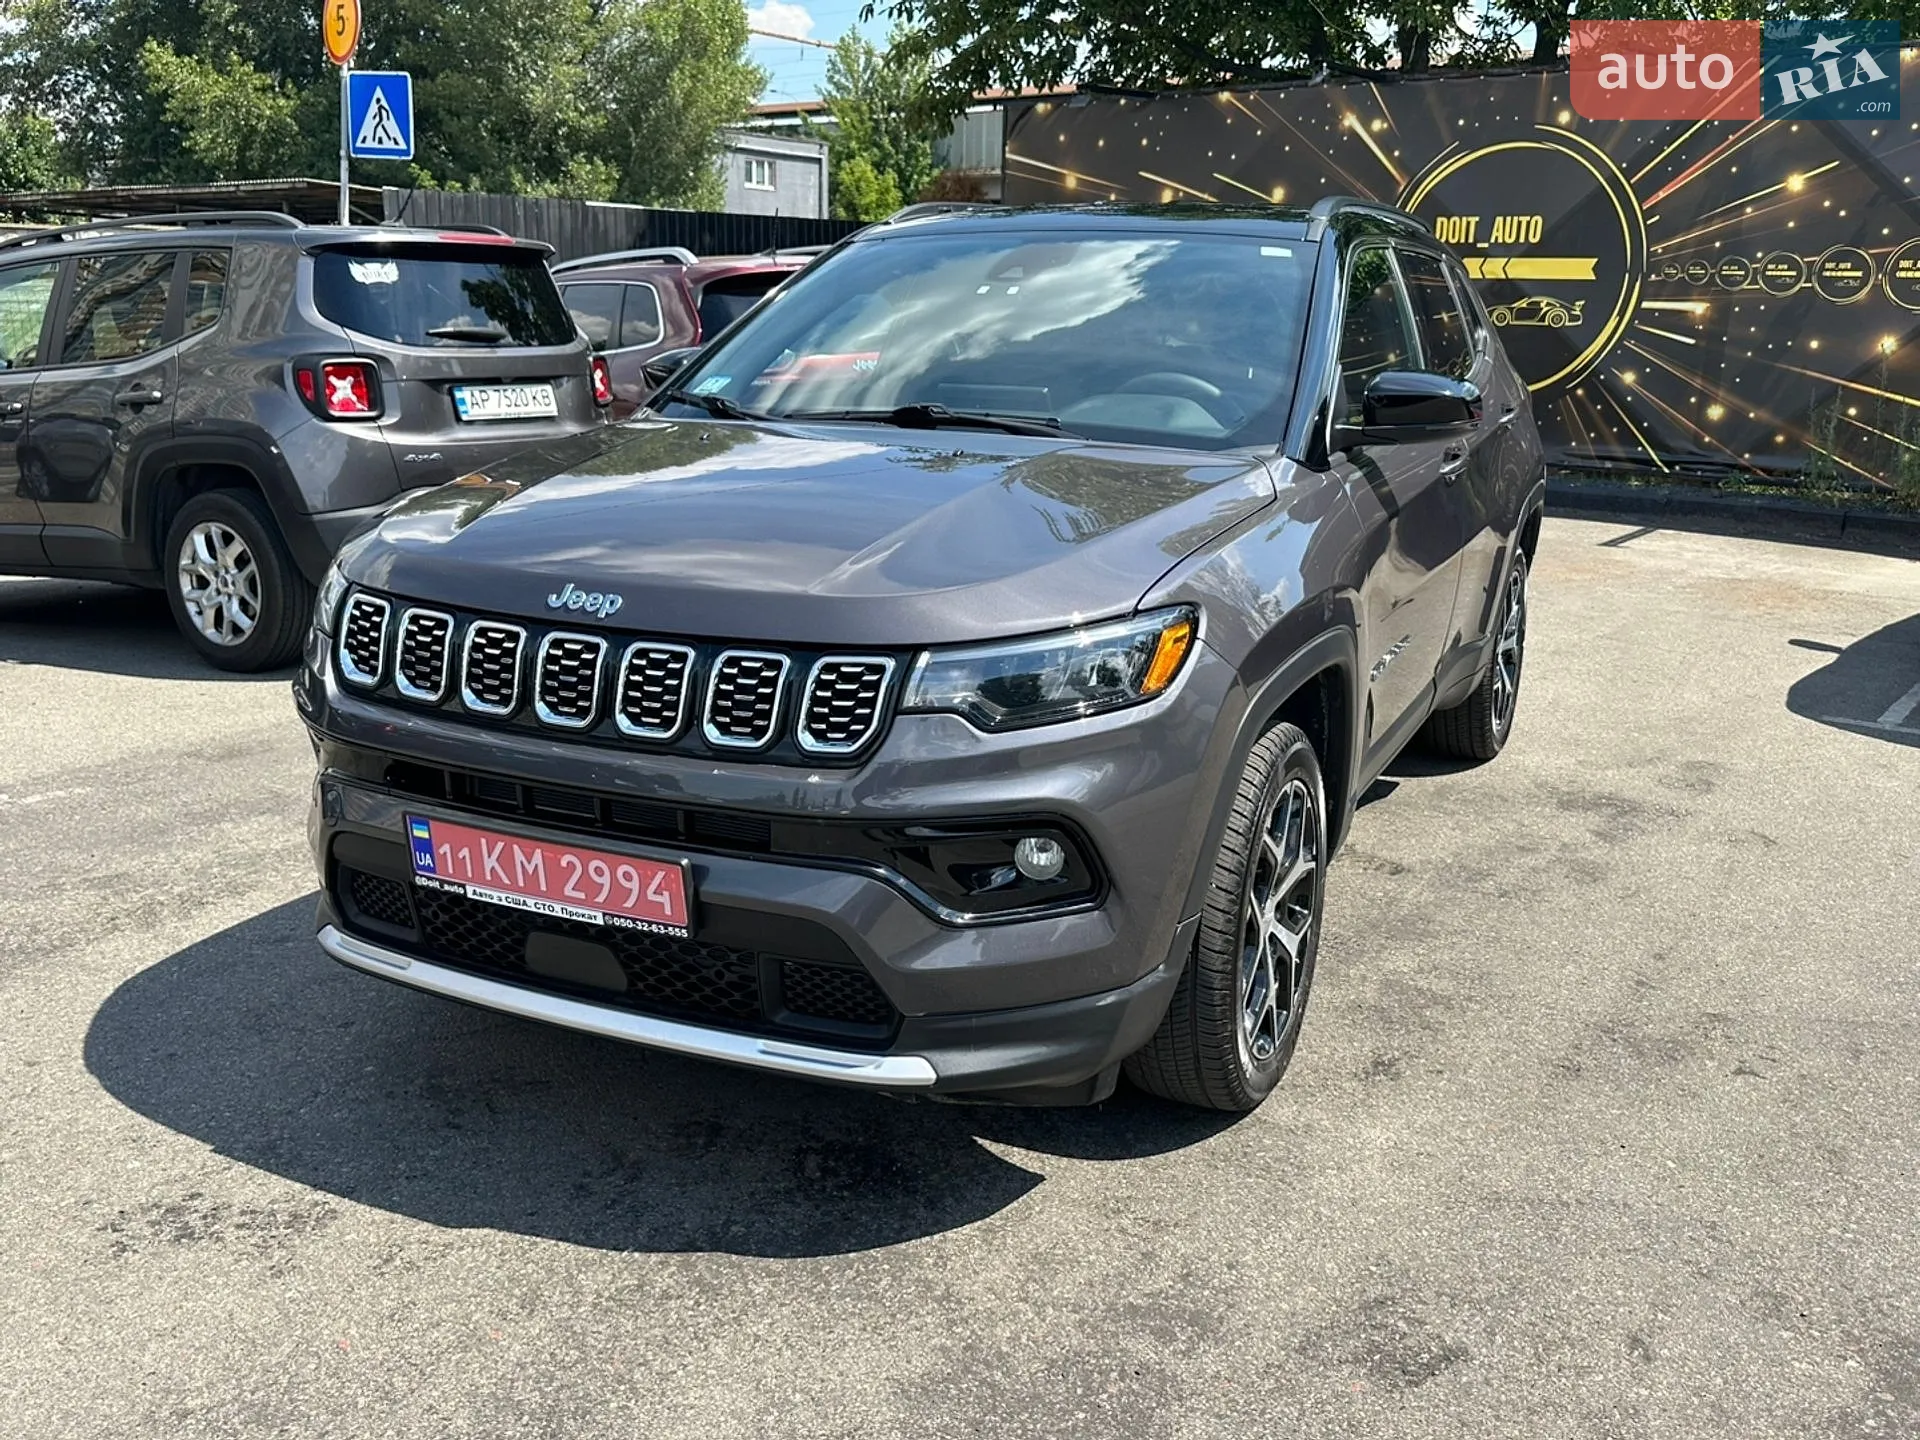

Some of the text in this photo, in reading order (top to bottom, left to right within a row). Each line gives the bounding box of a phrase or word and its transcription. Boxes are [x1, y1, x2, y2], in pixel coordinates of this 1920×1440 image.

[335, 4, 346, 36] 5
[1435, 215, 1543, 248] DOIT_AUTO
[470, 388, 552, 410] AP 7520 KB
[547, 583, 623, 618] Jeep
[415, 851, 434, 868] UA
[560, 853, 673, 916] 2994
[471, 888, 495, 901] Авто
[560, 906, 598, 922] Прокат
[613, 917, 689, 938] 050-32-63-555
